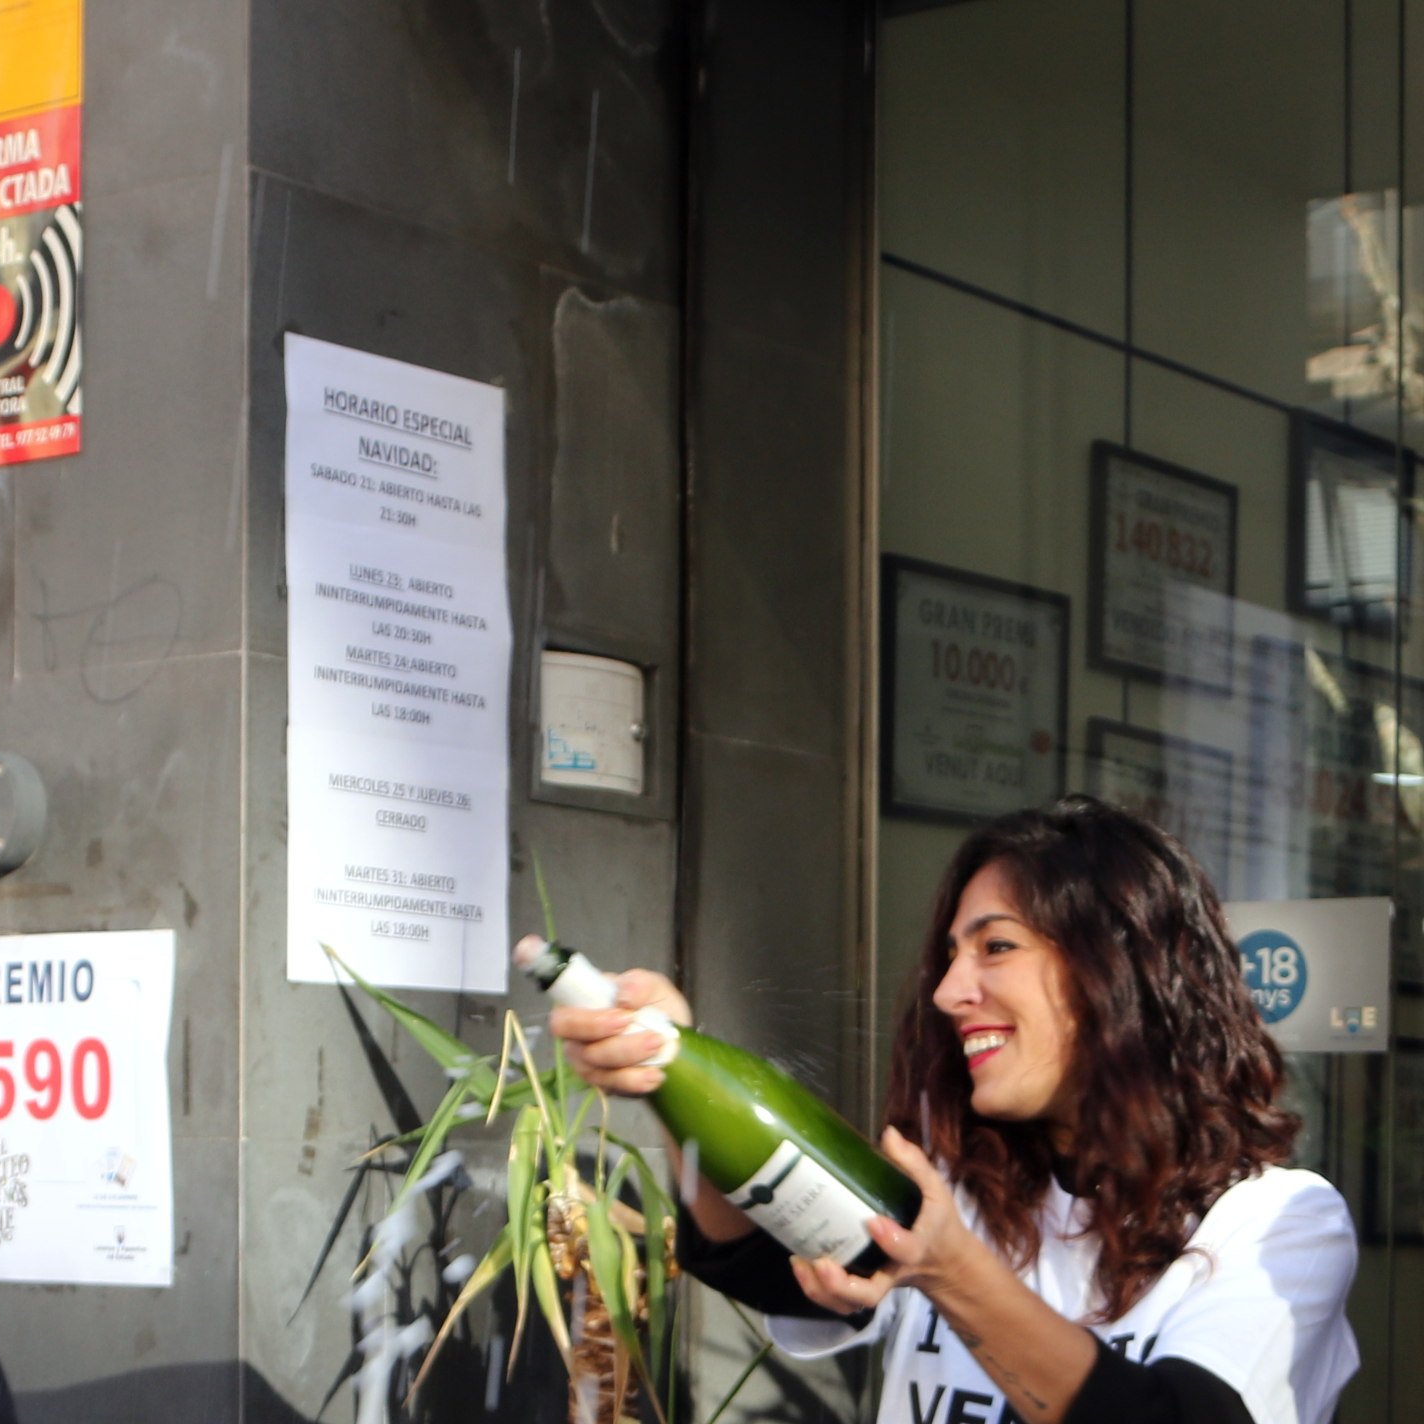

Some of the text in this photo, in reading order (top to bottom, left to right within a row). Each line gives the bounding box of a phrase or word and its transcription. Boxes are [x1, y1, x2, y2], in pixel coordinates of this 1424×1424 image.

[323, 386, 472, 446] HORARIO ESPECIAL
[359, 435, 438, 475] NAVIDAD:
[311, 463, 356, 487] SABADO
[379, 481, 424, 504] ABIERTO
[427, 491, 461, 513] HASTA
[463, 499, 482, 518] LAS
[380, 506, 416, 528] 21:30H
[349, 564, 384, 584] LUNES
[408, 576, 454, 599] ABIERTO
[315, 582, 487, 631] ININTERRUMPIDAMENTE HASTA
[372, 620, 391, 637] LAS
[346, 645, 391, 666] MARTES
[314, 665, 486, 710] ININTERRUMPIDAMENTE HASTA
[371, 702, 391, 718] LAS
[329, 773, 389, 794] MIERCOLES
[417, 786, 453, 805] JUEVES
[376, 809, 426, 829] CERRADO
[344, 864, 389, 883] MARTES
[410, 872, 455, 892] ABIERTO
[314, 886, 483, 920] ININTERRUMPIDAMENTE HASTA
[371, 918, 390, 934] LAS
